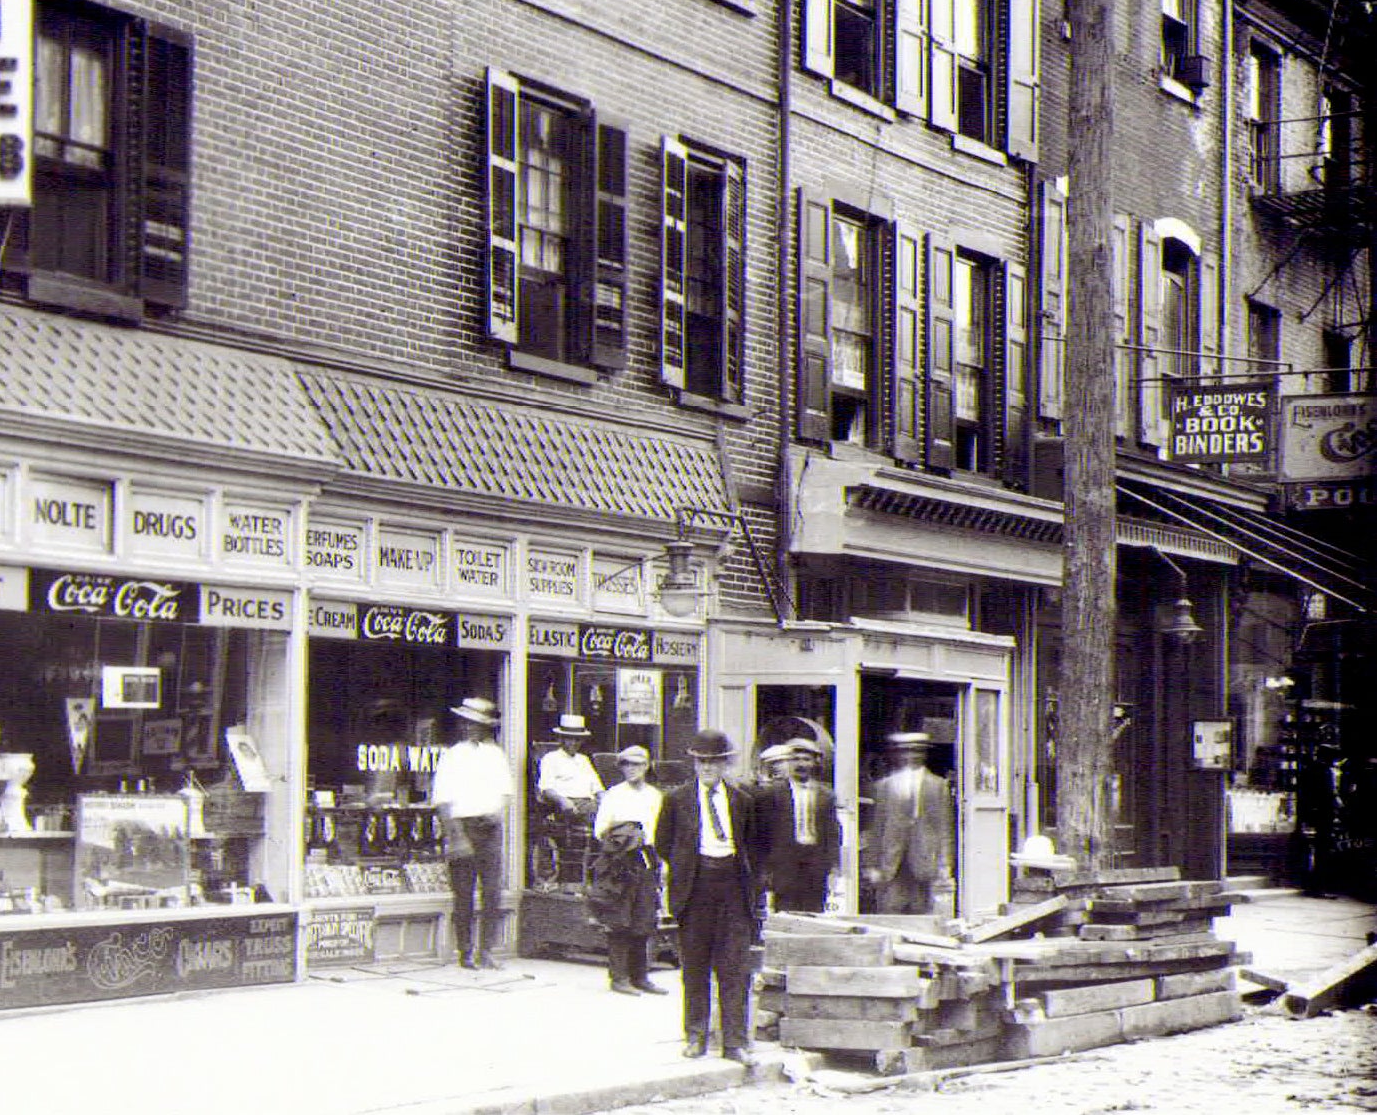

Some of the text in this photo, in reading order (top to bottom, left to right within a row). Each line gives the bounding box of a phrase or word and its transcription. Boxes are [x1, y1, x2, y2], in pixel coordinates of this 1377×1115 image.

[1193, 392, 1268, 408] EDDOWES
[1199, 405, 1215, 417] &
[1185, 416, 1255, 433] BOOK
[1175, 432, 1263, 455] BINDERS
[34, 497, 96, 530] NOLTE
[133, 510, 197, 540] DRUGS
[228, 512, 283, 535] WATER
[223, 534, 285, 557] BOTTLES
[305, 529, 358, 551] ERFUMES
[305, 549, 354, 570] SOAPS
[455, 548, 502, 568] TOILET
[456, 565, 499, 586] WATER
[47, 574, 110, 613] Coca
[114, 581, 182, 620] Cola
[207, 590, 285, 621] PRICES
[316, 606, 356, 631] CREAM
[363, 607, 404, 639] Coca
[405, 611, 449, 645] Cola
[529, 625, 578, 648] ELASTIC
[582, 627, 614, 657] Coca
[613, 631, 650, 659] Cola
[357, 744, 441, 772] SODA WAT
